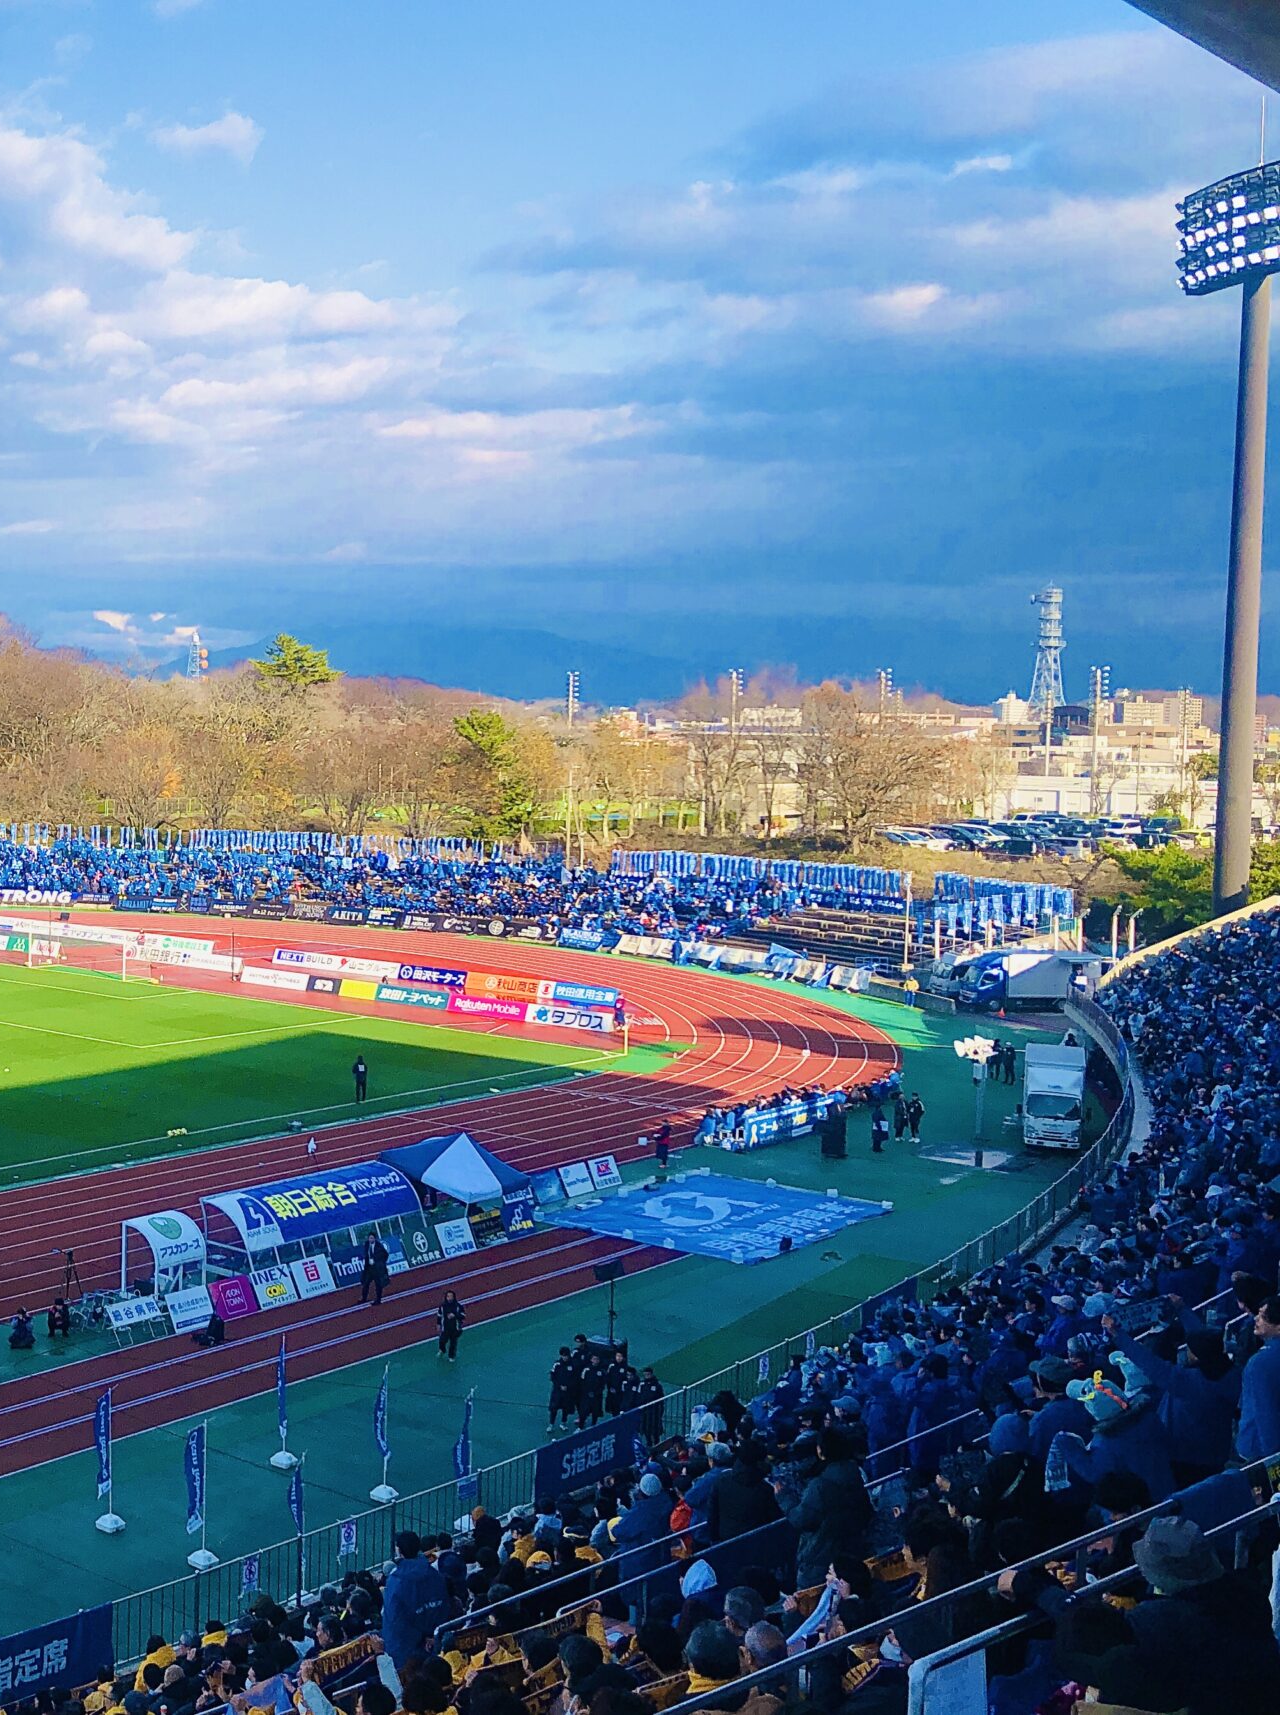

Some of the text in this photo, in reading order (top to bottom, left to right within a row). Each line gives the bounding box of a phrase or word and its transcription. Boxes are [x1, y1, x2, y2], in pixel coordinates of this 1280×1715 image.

[332, 910, 363, 921] AKITA
[139, 947, 181, 964] 秋田銀行
[279, 951, 333, 965] NEXT BUILD
[380, 988, 445, 1006] 秋田トヨペット
[454, 997, 521, 1016] Rakuten Mobile
[160, 1238, 201, 1259] アスカフーズ
[252, 1265, 289, 1286] INEX
[112, 1301, 158, 1322] 細谷病院
[561, 1433, 616, 1480] S指定席
